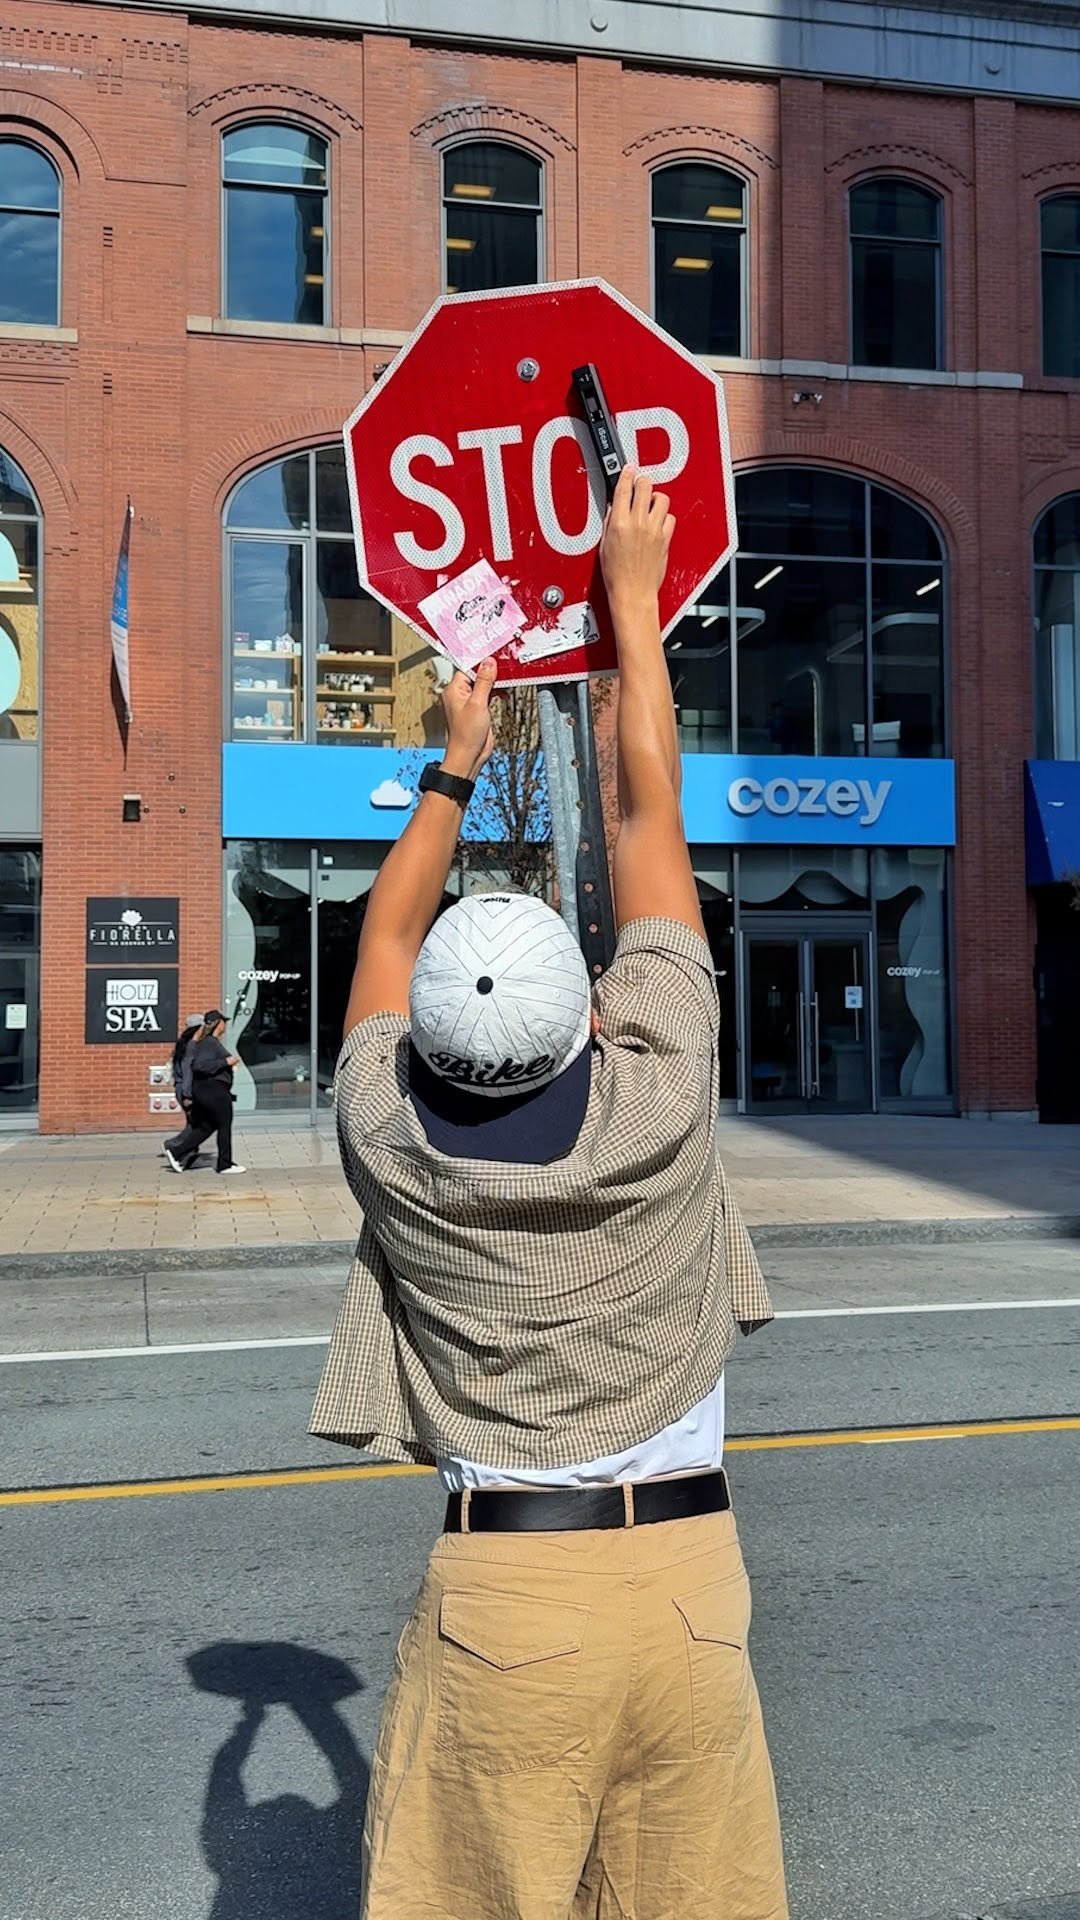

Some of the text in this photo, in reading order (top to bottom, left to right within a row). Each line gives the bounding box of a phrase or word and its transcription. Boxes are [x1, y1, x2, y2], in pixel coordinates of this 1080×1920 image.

[597, 426, 610, 450] iScan
[389, 406, 690, 571] STOP
[727, 777, 893, 826] cozey
[89, 929, 176, 941] FIORELLA
[238, 970, 279, 982] cozey
[887, 967, 921, 978] cozey
[106, 983, 158, 1001] HOLTZ
[105, 1006, 162, 1032] SPA
